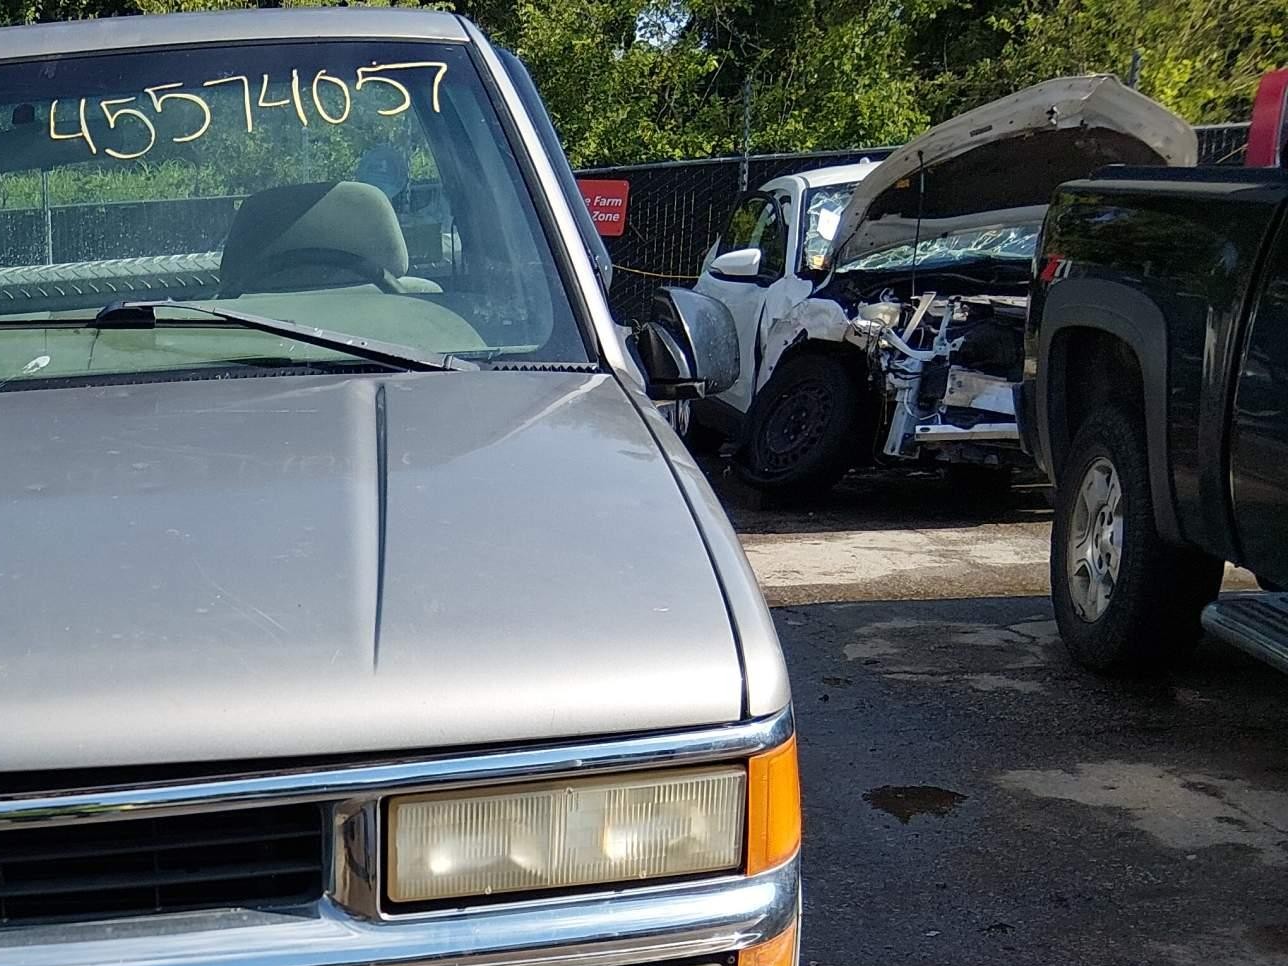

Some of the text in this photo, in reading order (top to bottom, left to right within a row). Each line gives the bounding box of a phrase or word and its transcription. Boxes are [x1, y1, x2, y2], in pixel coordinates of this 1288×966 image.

[49, 61, 448, 160] 45574057
[593, 195, 622, 207] Farm
[592, 210, 620, 221] Zone
[1040, 253, 1073, 282] Z71
